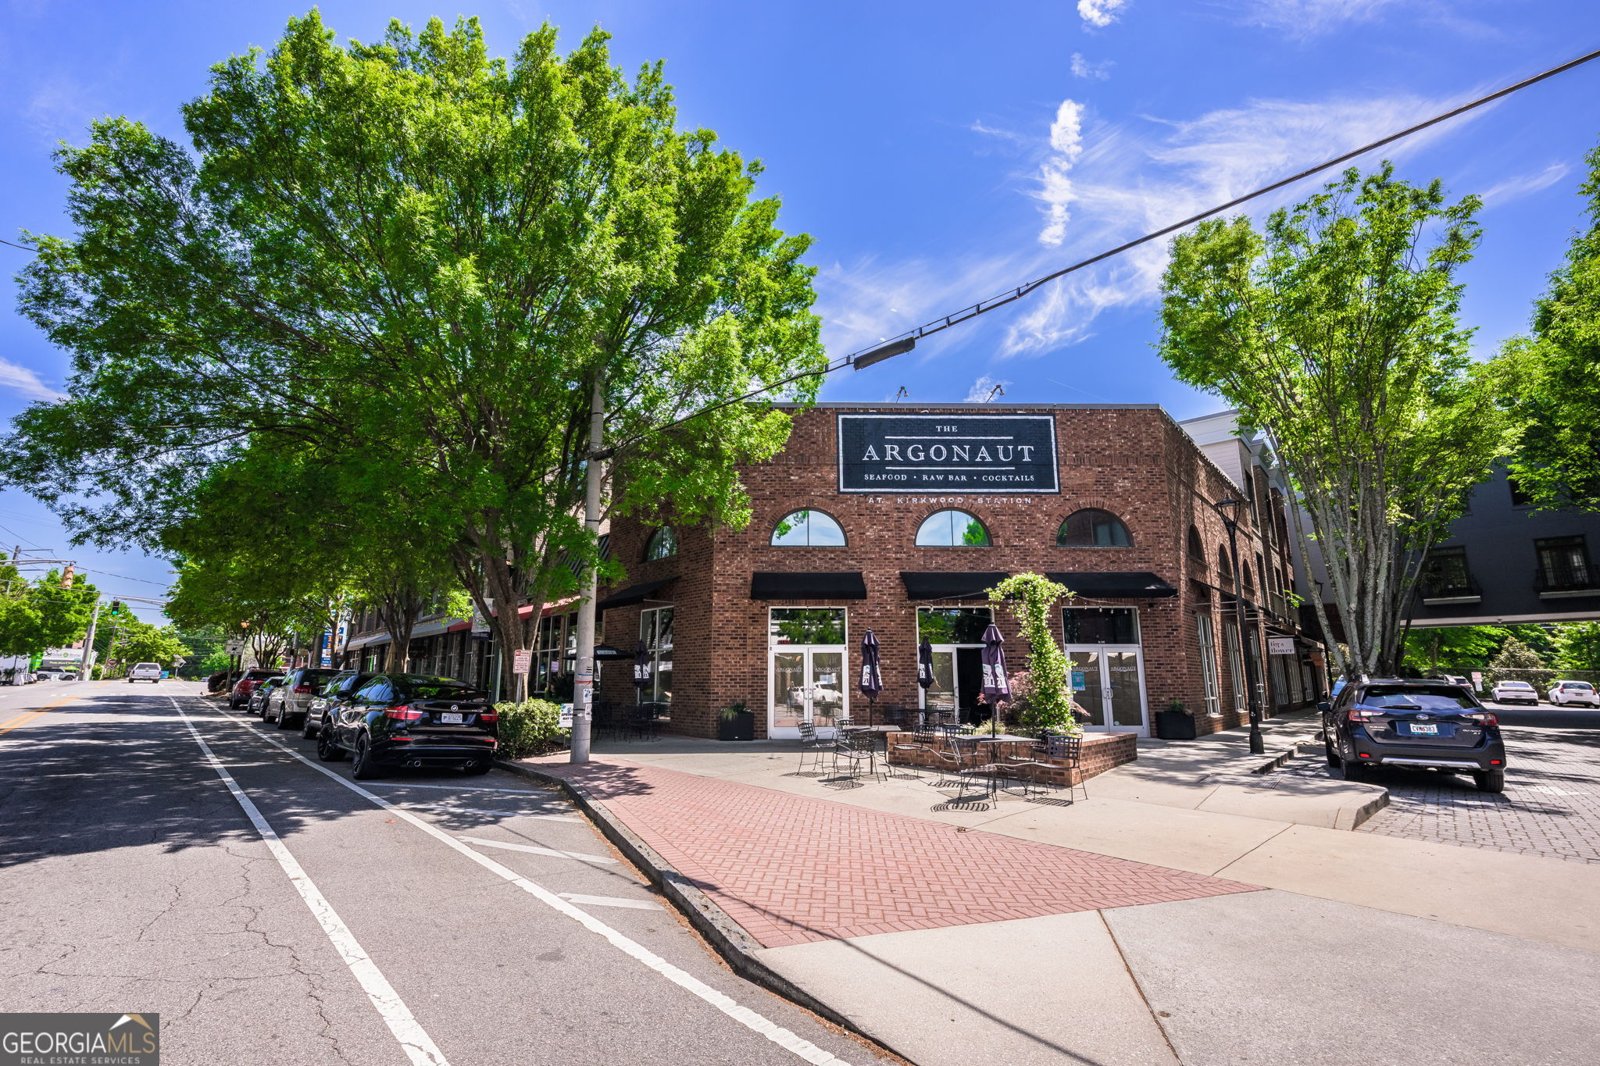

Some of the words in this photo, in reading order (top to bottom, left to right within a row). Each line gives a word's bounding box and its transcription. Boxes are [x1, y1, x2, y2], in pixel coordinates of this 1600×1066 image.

[936, 425, 958, 433] THE
[862, 444, 1035, 462] ARGONAUT
[864, 473, 908, 481] SEAFOOD
[948, 474, 968, 482] BAR
[982, 474, 1035, 482] COCKTAILS
